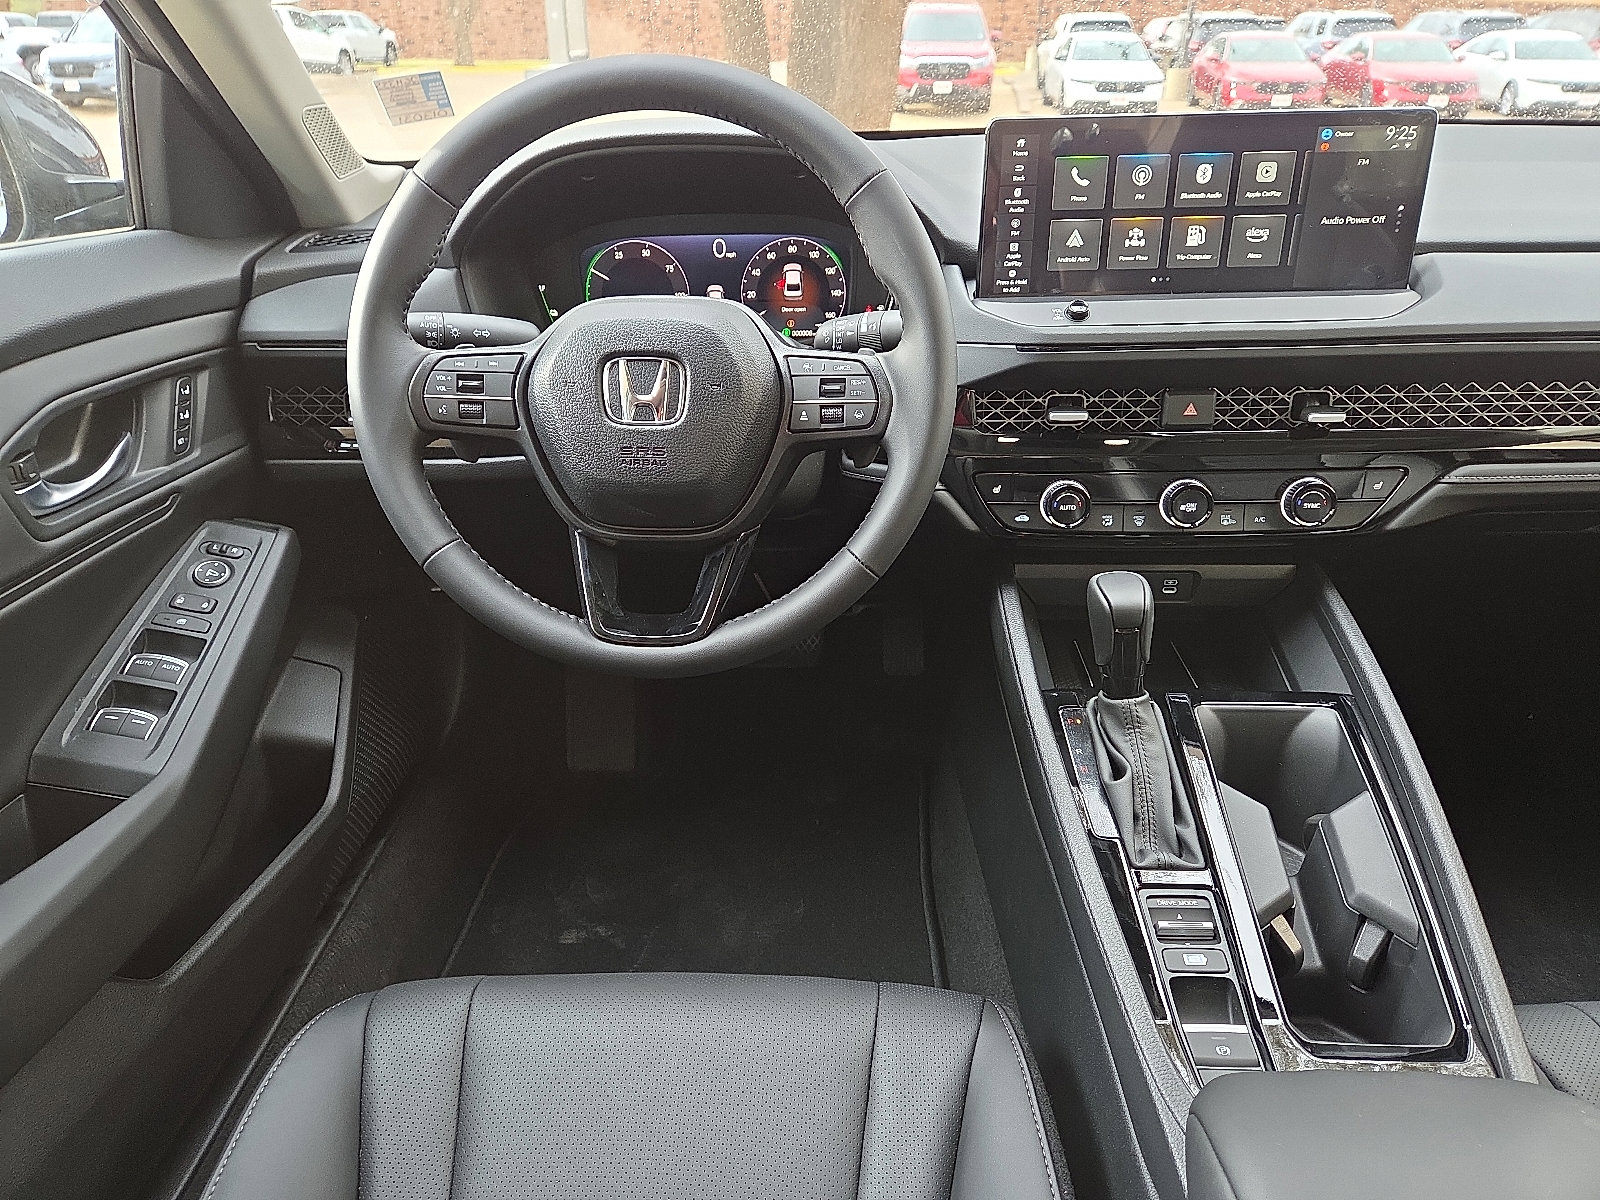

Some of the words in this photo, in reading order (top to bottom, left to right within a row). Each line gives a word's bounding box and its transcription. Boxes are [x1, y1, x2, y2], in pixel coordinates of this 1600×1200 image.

[1334, 130, 1355, 138] Owner
[1384, 125, 1418, 142] 9:25
[1356, 158, 1370, 166] FM
[1134, 193, 1146, 201] FM
[1206, 191, 1223, 199] Audio
[1245, 190, 1261, 198] Apple
[1262, 190, 1283, 198] CarPlay
[1320, 216, 1344, 225] Audio
[1345, 215, 1371, 225] Power
[1371, 214, 1387, 224] Off
[1245, 226, 1270, 237] alexa
[712, 238, 727, 258] 0
[787, 244, 798, 253] 80
[614, 250, 624, 260] 25
[641, 248, 651, 257] 50
[766, 252, 777, 260] 60
[808, 251, 820, 259] 100
[1005, 252, 1022, 260] Apple
[1246, 252, 1263, 260] Alexa
[1186, 253, 1213, 261] Computer
[664, 264, 675, 273] 75
[751, 269, 761, 277] 40
[746, 291, 757, 299] 20
[830, 290, 842, 298] 140
[419, 321, 438, 329] AUTO
[619, 446, 667, 457] SRS
[618, 458, 668, 468] AIRBAG
[1059, 504, 1077, 512] AUTO
[161, 663, 181, 672] AUTO
